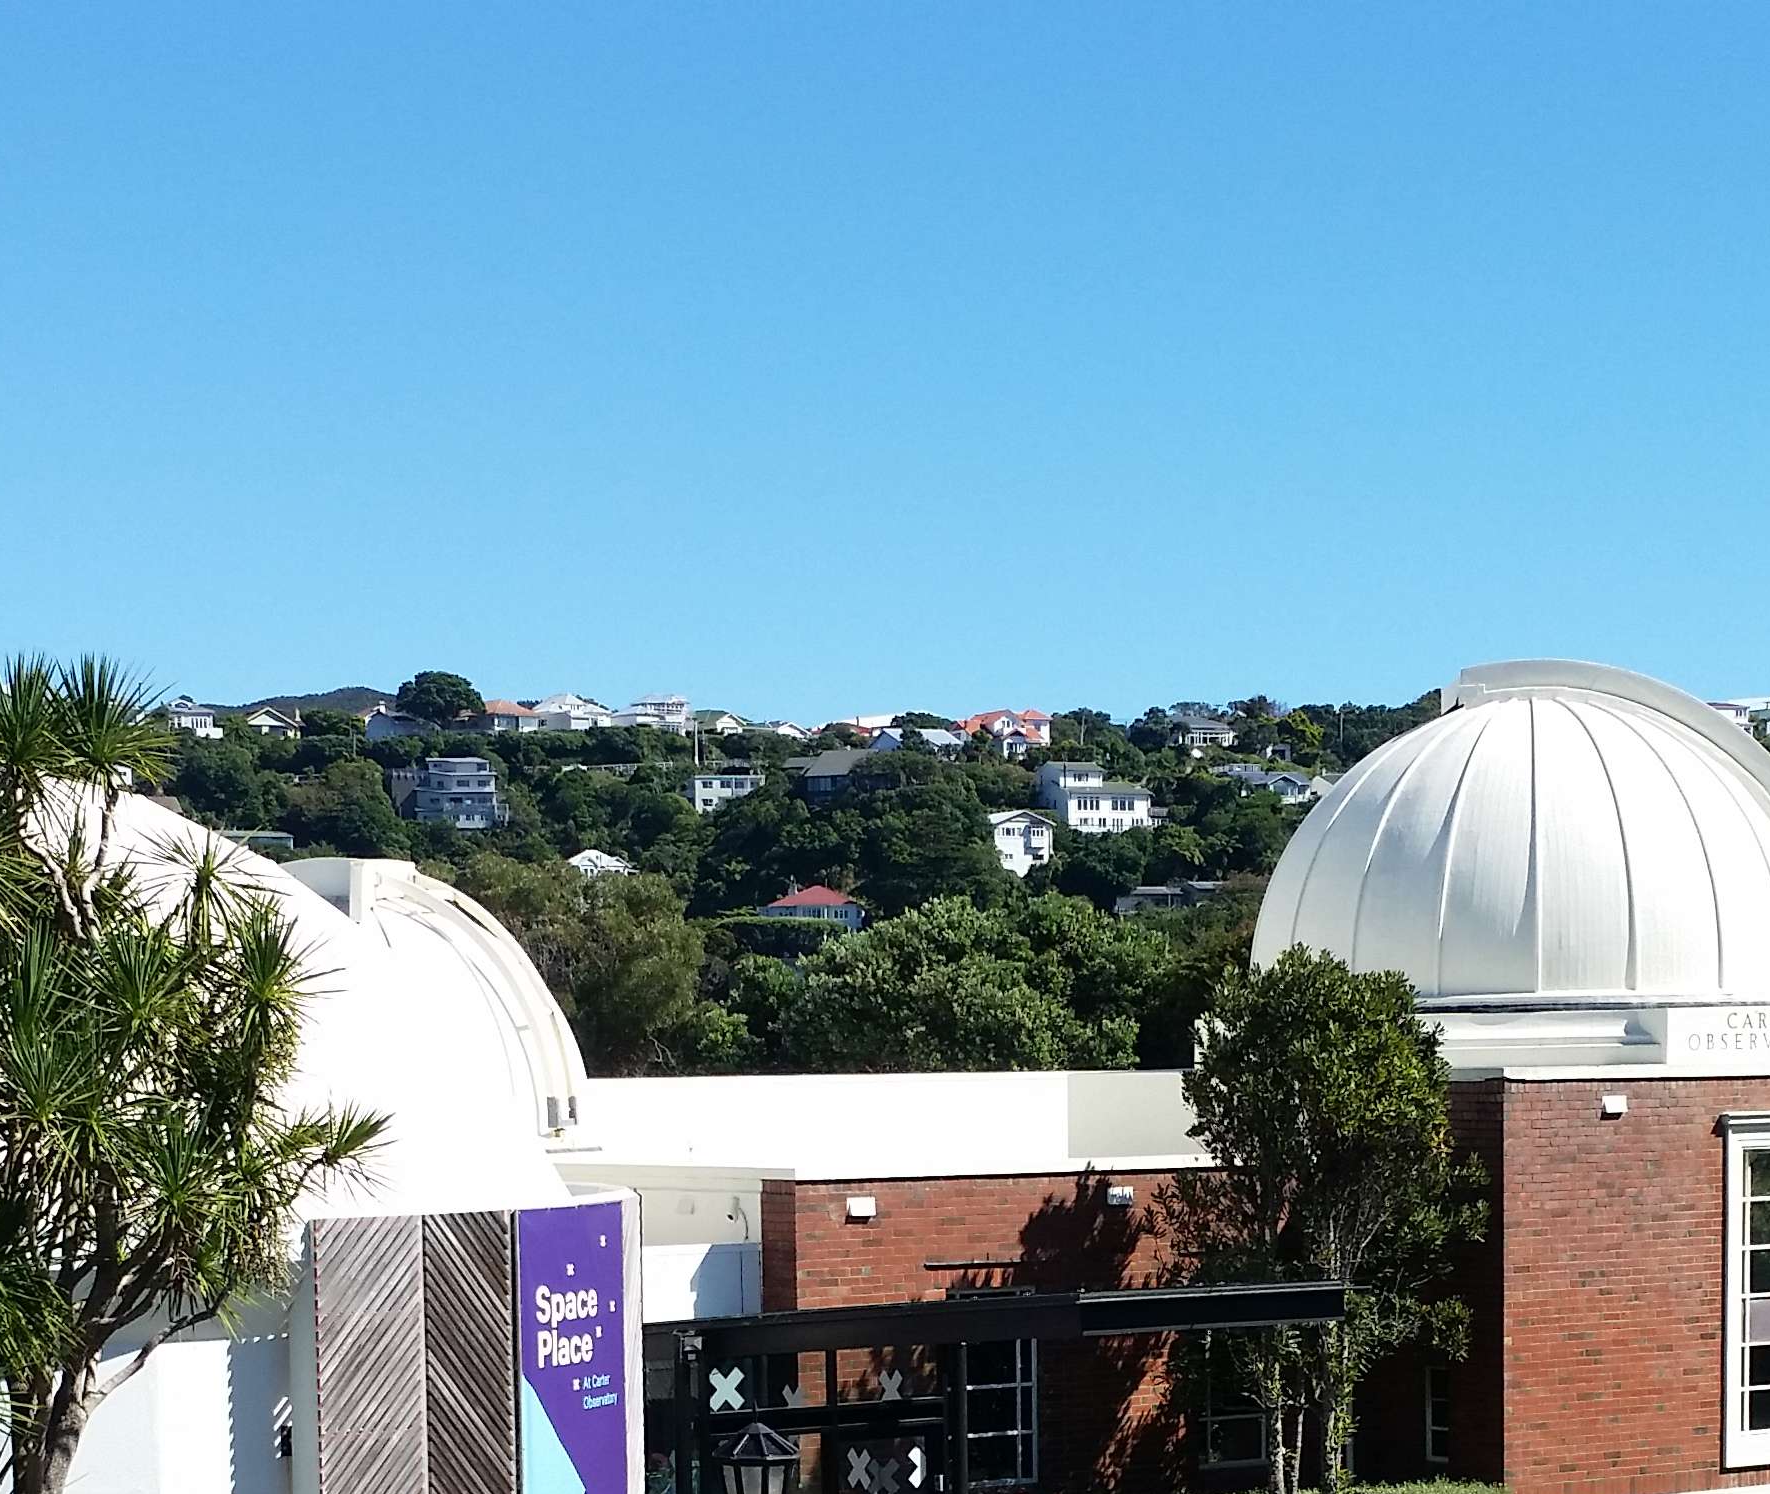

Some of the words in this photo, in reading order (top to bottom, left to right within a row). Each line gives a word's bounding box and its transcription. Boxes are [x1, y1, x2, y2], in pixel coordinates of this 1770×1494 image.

[535, 1285, 598, 1328] Space
[537, 1329, 593, 1369] Place
[582, 1377, 591, 1390] At
[592, 1374, 611, 1388] Carter
[583, 1392, 618, 1409] Observatory
